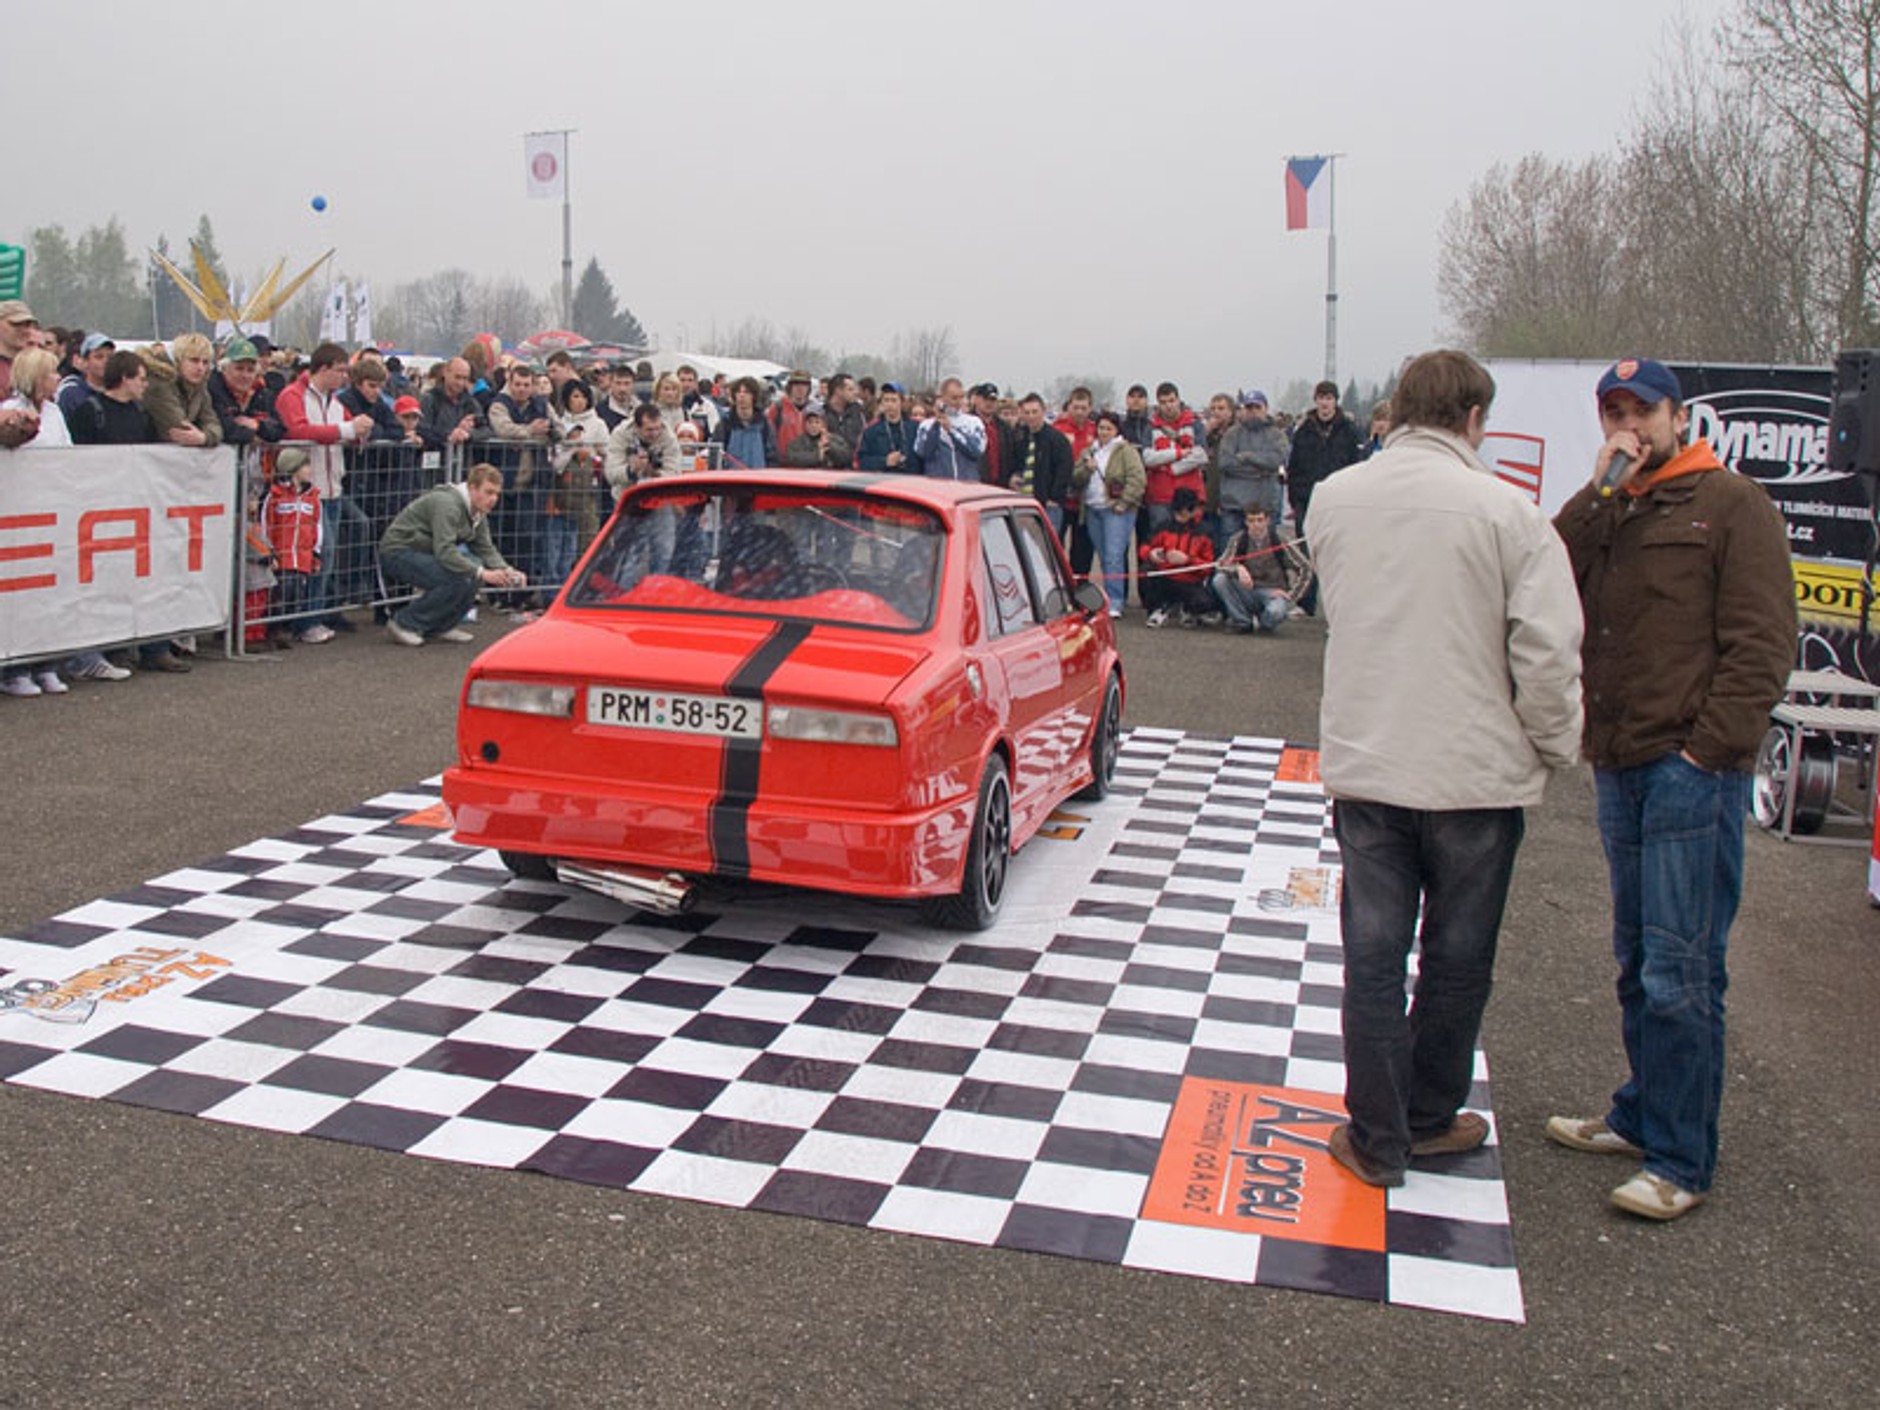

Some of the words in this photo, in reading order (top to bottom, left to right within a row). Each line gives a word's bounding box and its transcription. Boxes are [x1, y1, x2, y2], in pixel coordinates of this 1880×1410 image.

[601, 692, 650, 723] PRM
[671, 698, 748, 733] 58-52
[1194, 1152, 1220, 1171] od
[1189, 1170, 1219, 1181] A
[1185, 1184, 1214, 1201] do
[1182, 1201, 1212, 1213] Z
